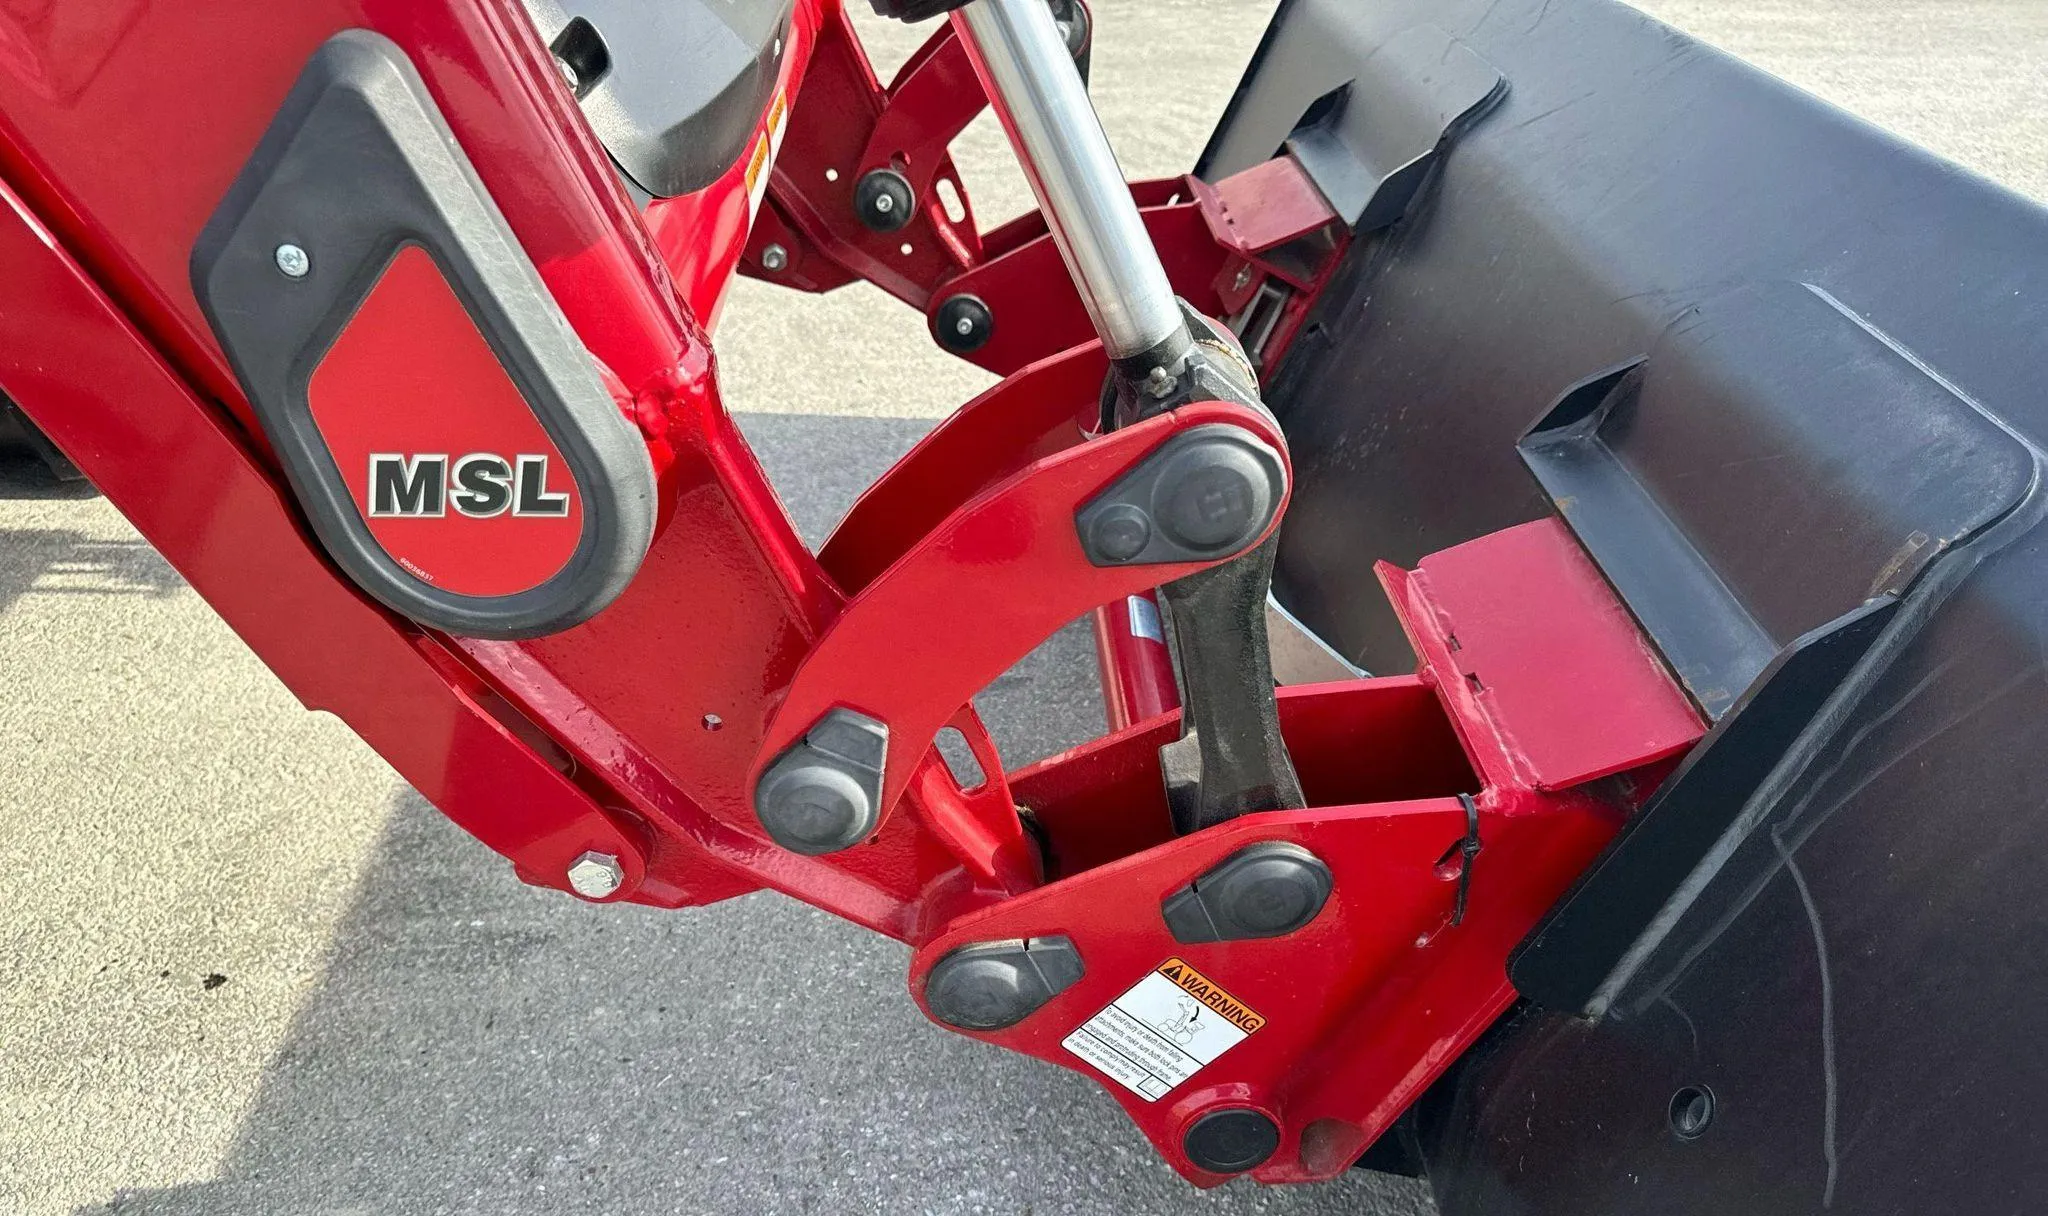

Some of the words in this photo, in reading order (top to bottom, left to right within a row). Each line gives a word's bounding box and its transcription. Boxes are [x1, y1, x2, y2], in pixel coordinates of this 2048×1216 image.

[368, 452, 570, 519] MSL
[1181, 973, 1259, 1033] WARNING
[1105, 1036, 1118, 1044] and
[1111, 1013, 1127, 1023] avoid
[1124, 1021, 1138, 1032] injury
[1156, 1042, 1169, 1052] from
[1074, 1042, 1089, 1052] death
[1095, 1056, 1115, 1069] serious
[1100, 1048, 1119, 1061] comply
[1118, 1059, 1130, 1068] may
[1125, 1036, 1139, 1046] make
[1137, 1044, 1149, 1053] sure
[1148, 1050, 1161, 1060] both
[1160, 1057, 1171, 1067] lock
